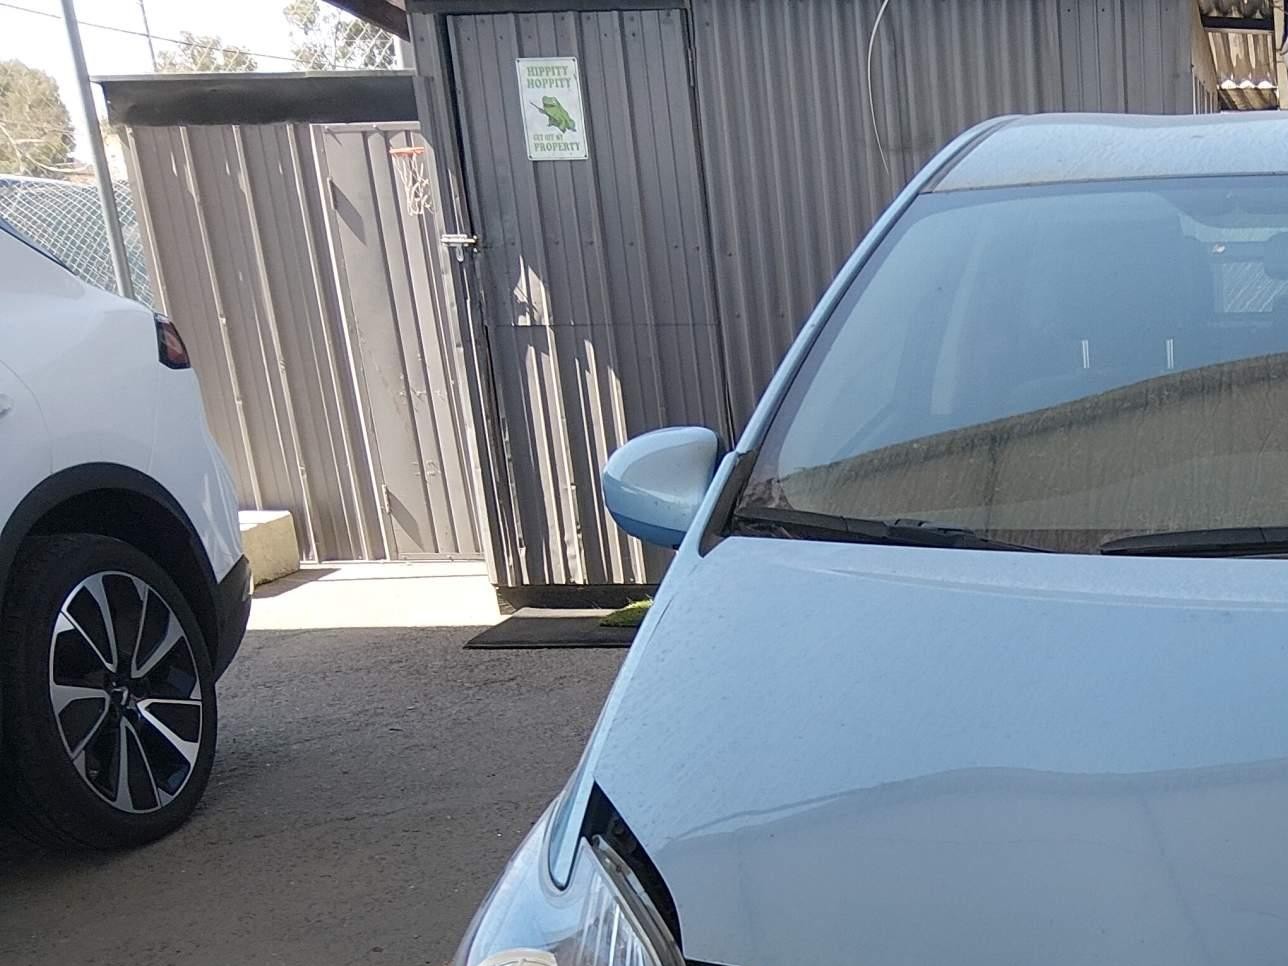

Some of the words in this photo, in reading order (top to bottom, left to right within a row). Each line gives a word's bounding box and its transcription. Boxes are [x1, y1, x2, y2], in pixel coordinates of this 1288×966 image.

[527, 65, 569, 77] HIPPITY
[527, 78, 571, 89] HOPPITY
[534, 142, 581, 152] PROPERTY
